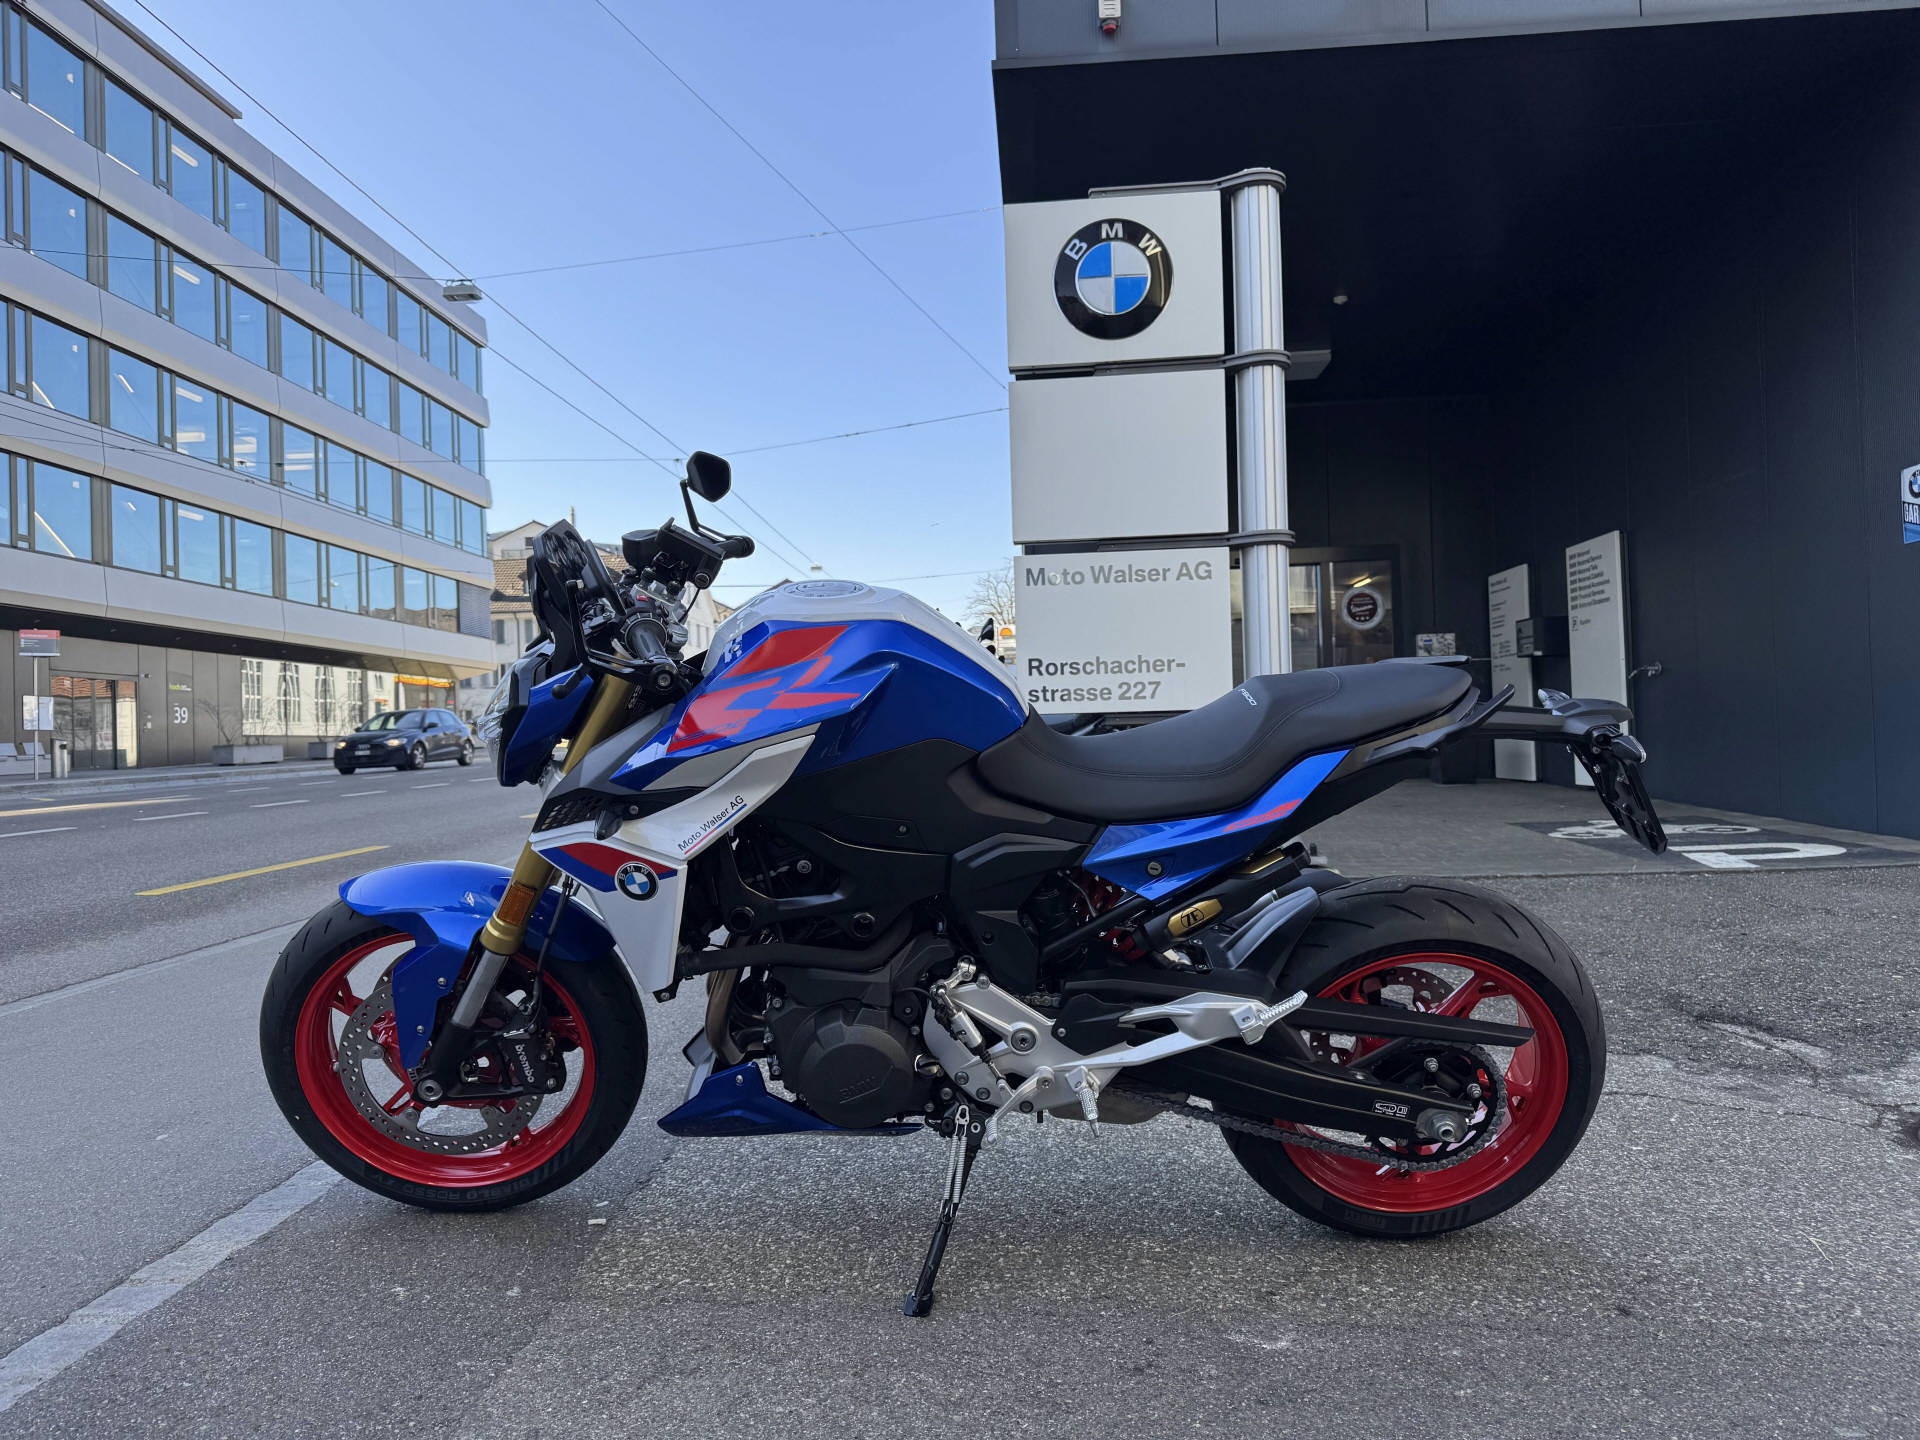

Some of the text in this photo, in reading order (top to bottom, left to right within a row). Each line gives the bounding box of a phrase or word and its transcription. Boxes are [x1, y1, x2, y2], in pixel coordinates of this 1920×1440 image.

[1064, 222, 1162, 261] BMW
[1025, 560, 1213, 587] Moto Walser AG
[1028, 655, 1186, 677] Rorschacher-
[1028, 681, 1161, 703] strasse 227
[173, 706, 188, 724] 39
[677, 795, 744, 851] Moto Walser AG
[617, 865, 650, 881] BMW
[514, 1043, 535, 1083] brembo
